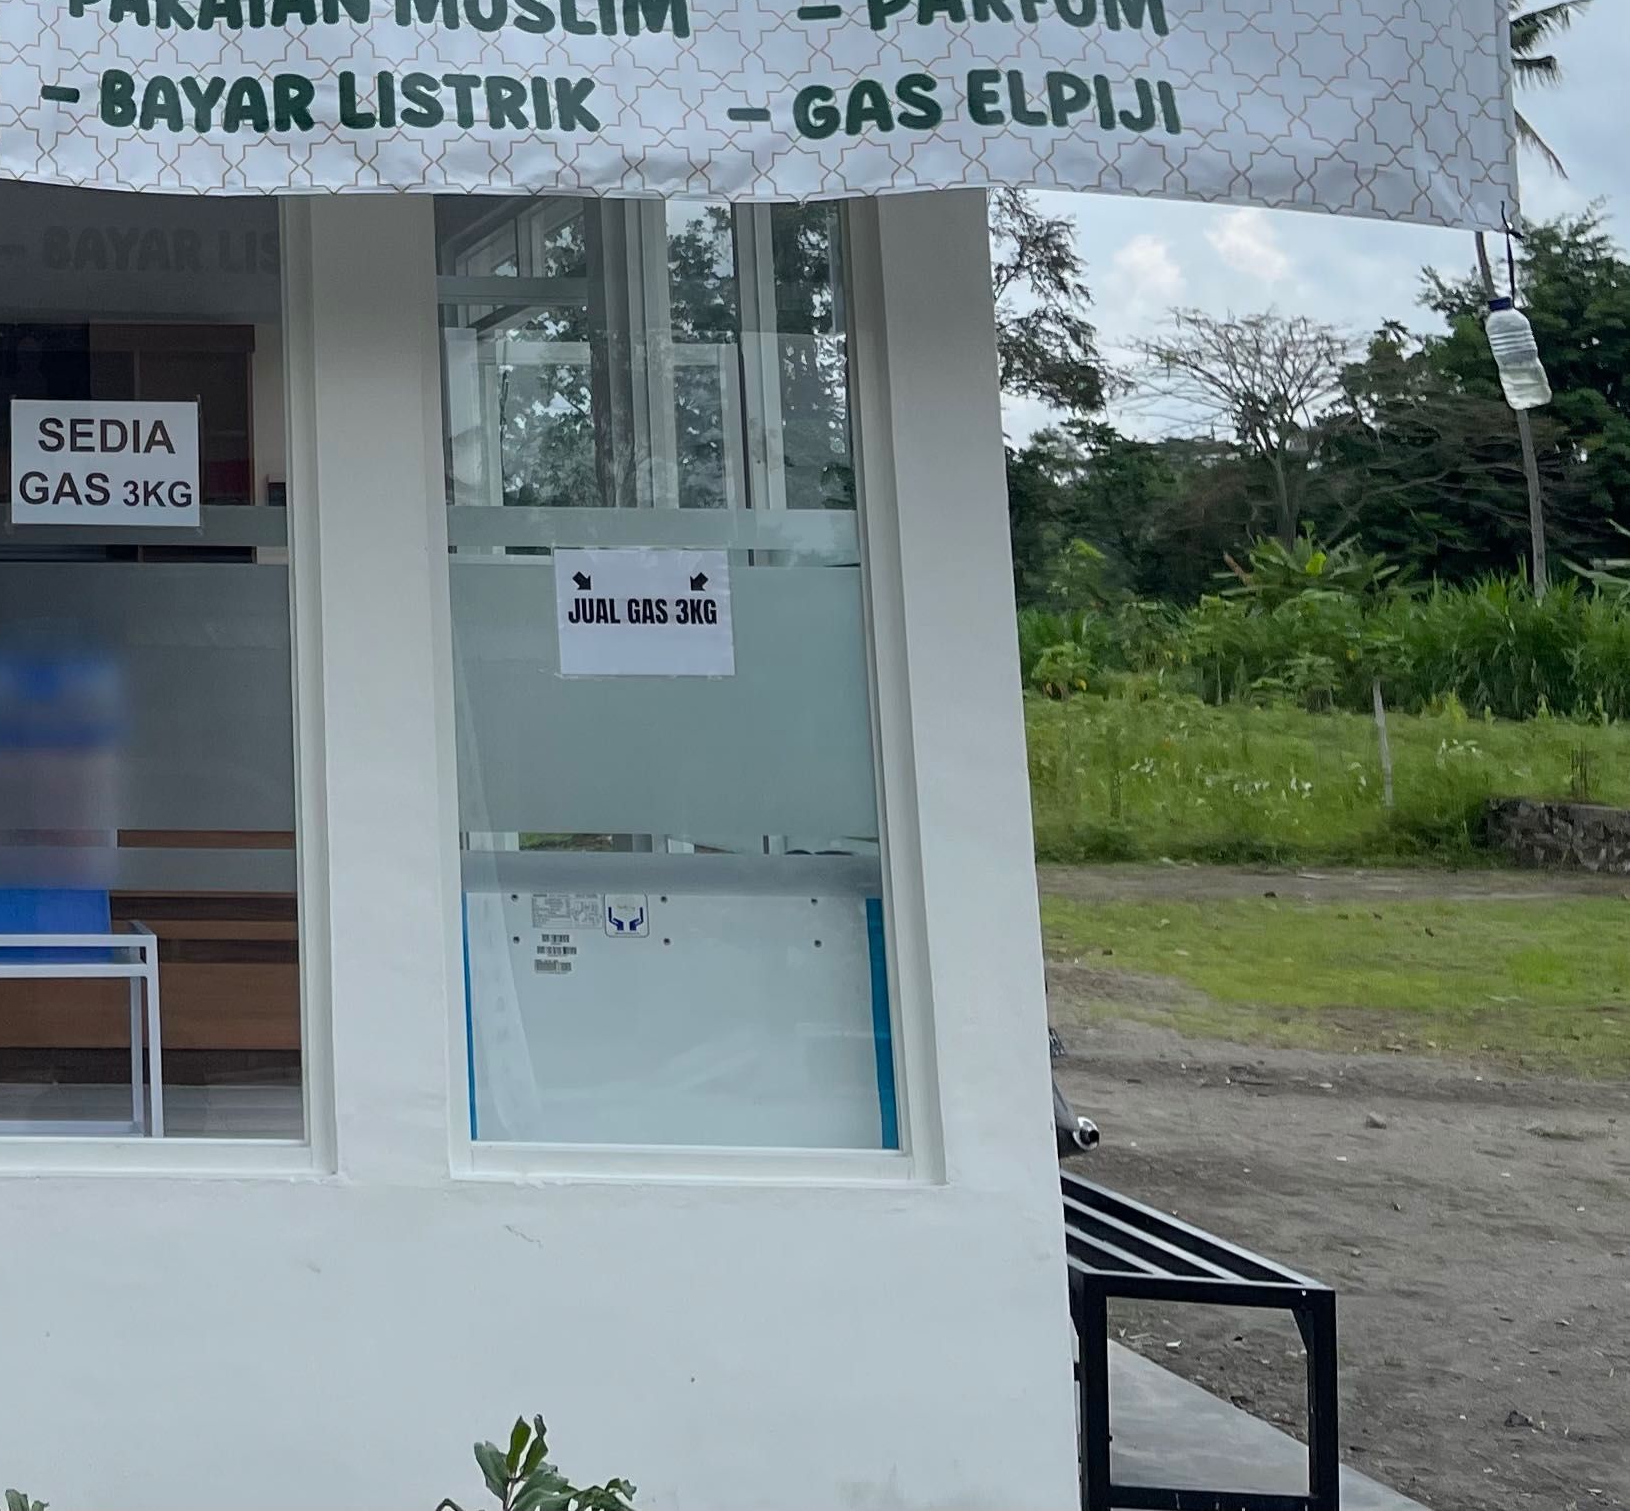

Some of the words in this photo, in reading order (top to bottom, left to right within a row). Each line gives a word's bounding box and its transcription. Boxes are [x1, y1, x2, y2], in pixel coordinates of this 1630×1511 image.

[101, 69, 316, 133] BAYAR
[338, 70, 600, 133] LISTRIK
[793, 74, 942, 139] GAS
[967, 69, 1180, 134] ELPIJI
[38, 418, 175, 454] SEDIA
[20, 471, 110, 506] GAS
[123, 481, 191, 507] 3KG
[569, 598, 620, 623] JUAL
[628, 599, 668, 624] GAS
[675, 599, 717, 624] 3KG
